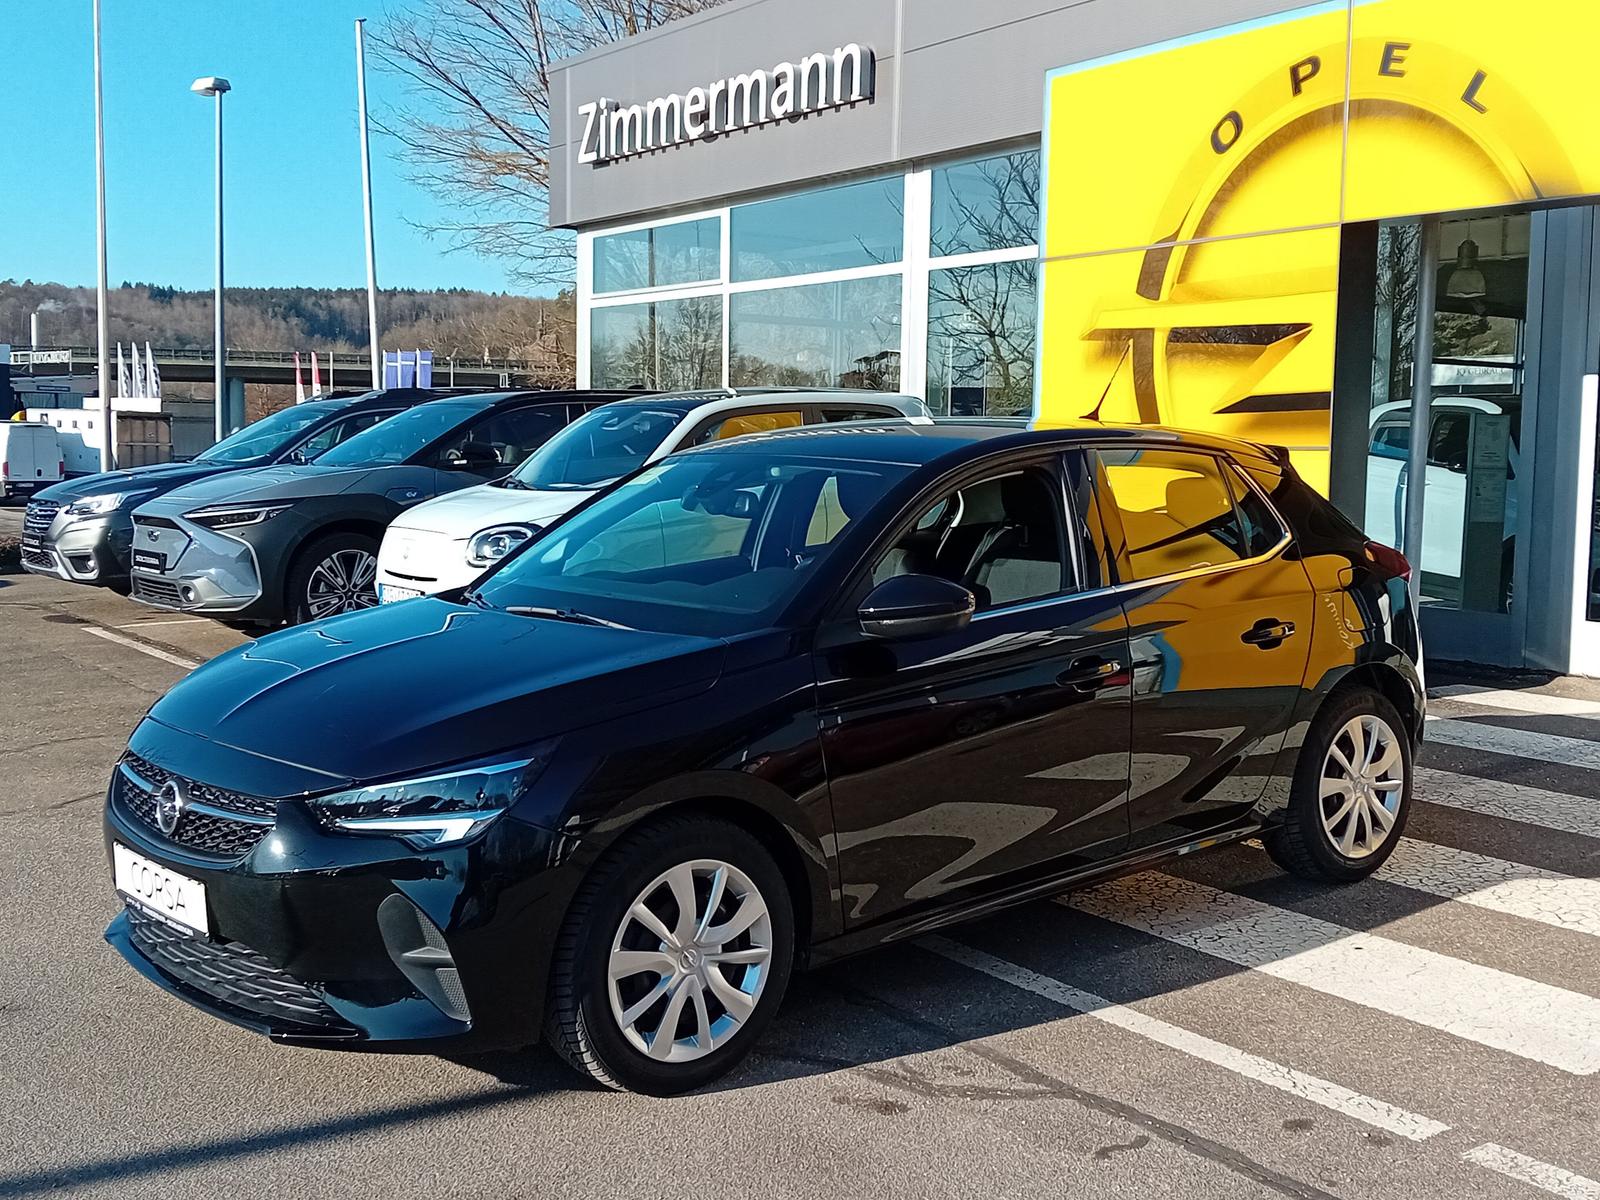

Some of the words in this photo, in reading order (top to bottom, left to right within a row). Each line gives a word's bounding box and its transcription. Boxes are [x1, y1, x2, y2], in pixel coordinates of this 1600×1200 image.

[577, 43, 868, 164] Zimmermann
[1210, 40, 1489, 155] OPEL
[131, 861, 189, 917] CORSA
